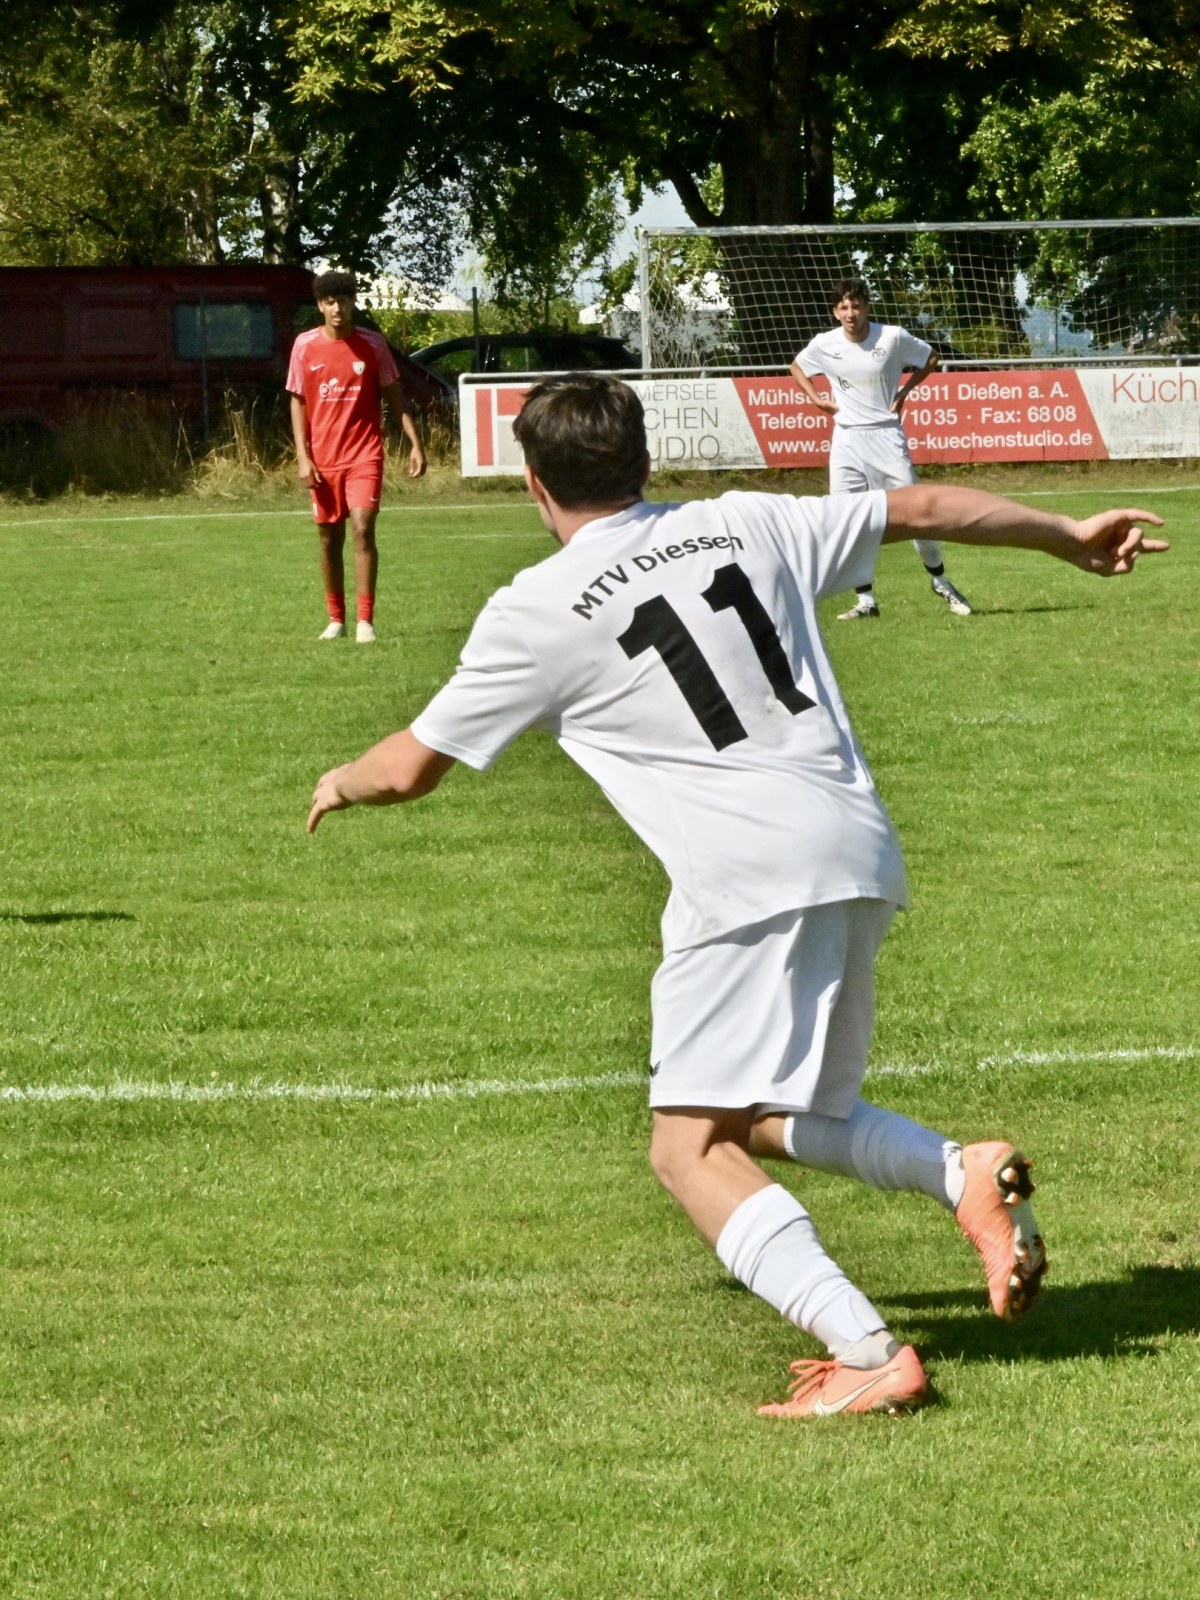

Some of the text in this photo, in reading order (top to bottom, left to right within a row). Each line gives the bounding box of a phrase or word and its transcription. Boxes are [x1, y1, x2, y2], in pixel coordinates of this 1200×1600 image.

[756, 412, 828, 431] Telefon
[981, 406, 1022, 425] Fax:
[957, 382, 1023, 401] Dießen
[1027, 385, 1045, 400] a.
[1049, 381, 1070, 399] A.
[570, 535, 745, 621] MTV Diessen
[616, 561, 818, 753] 11
